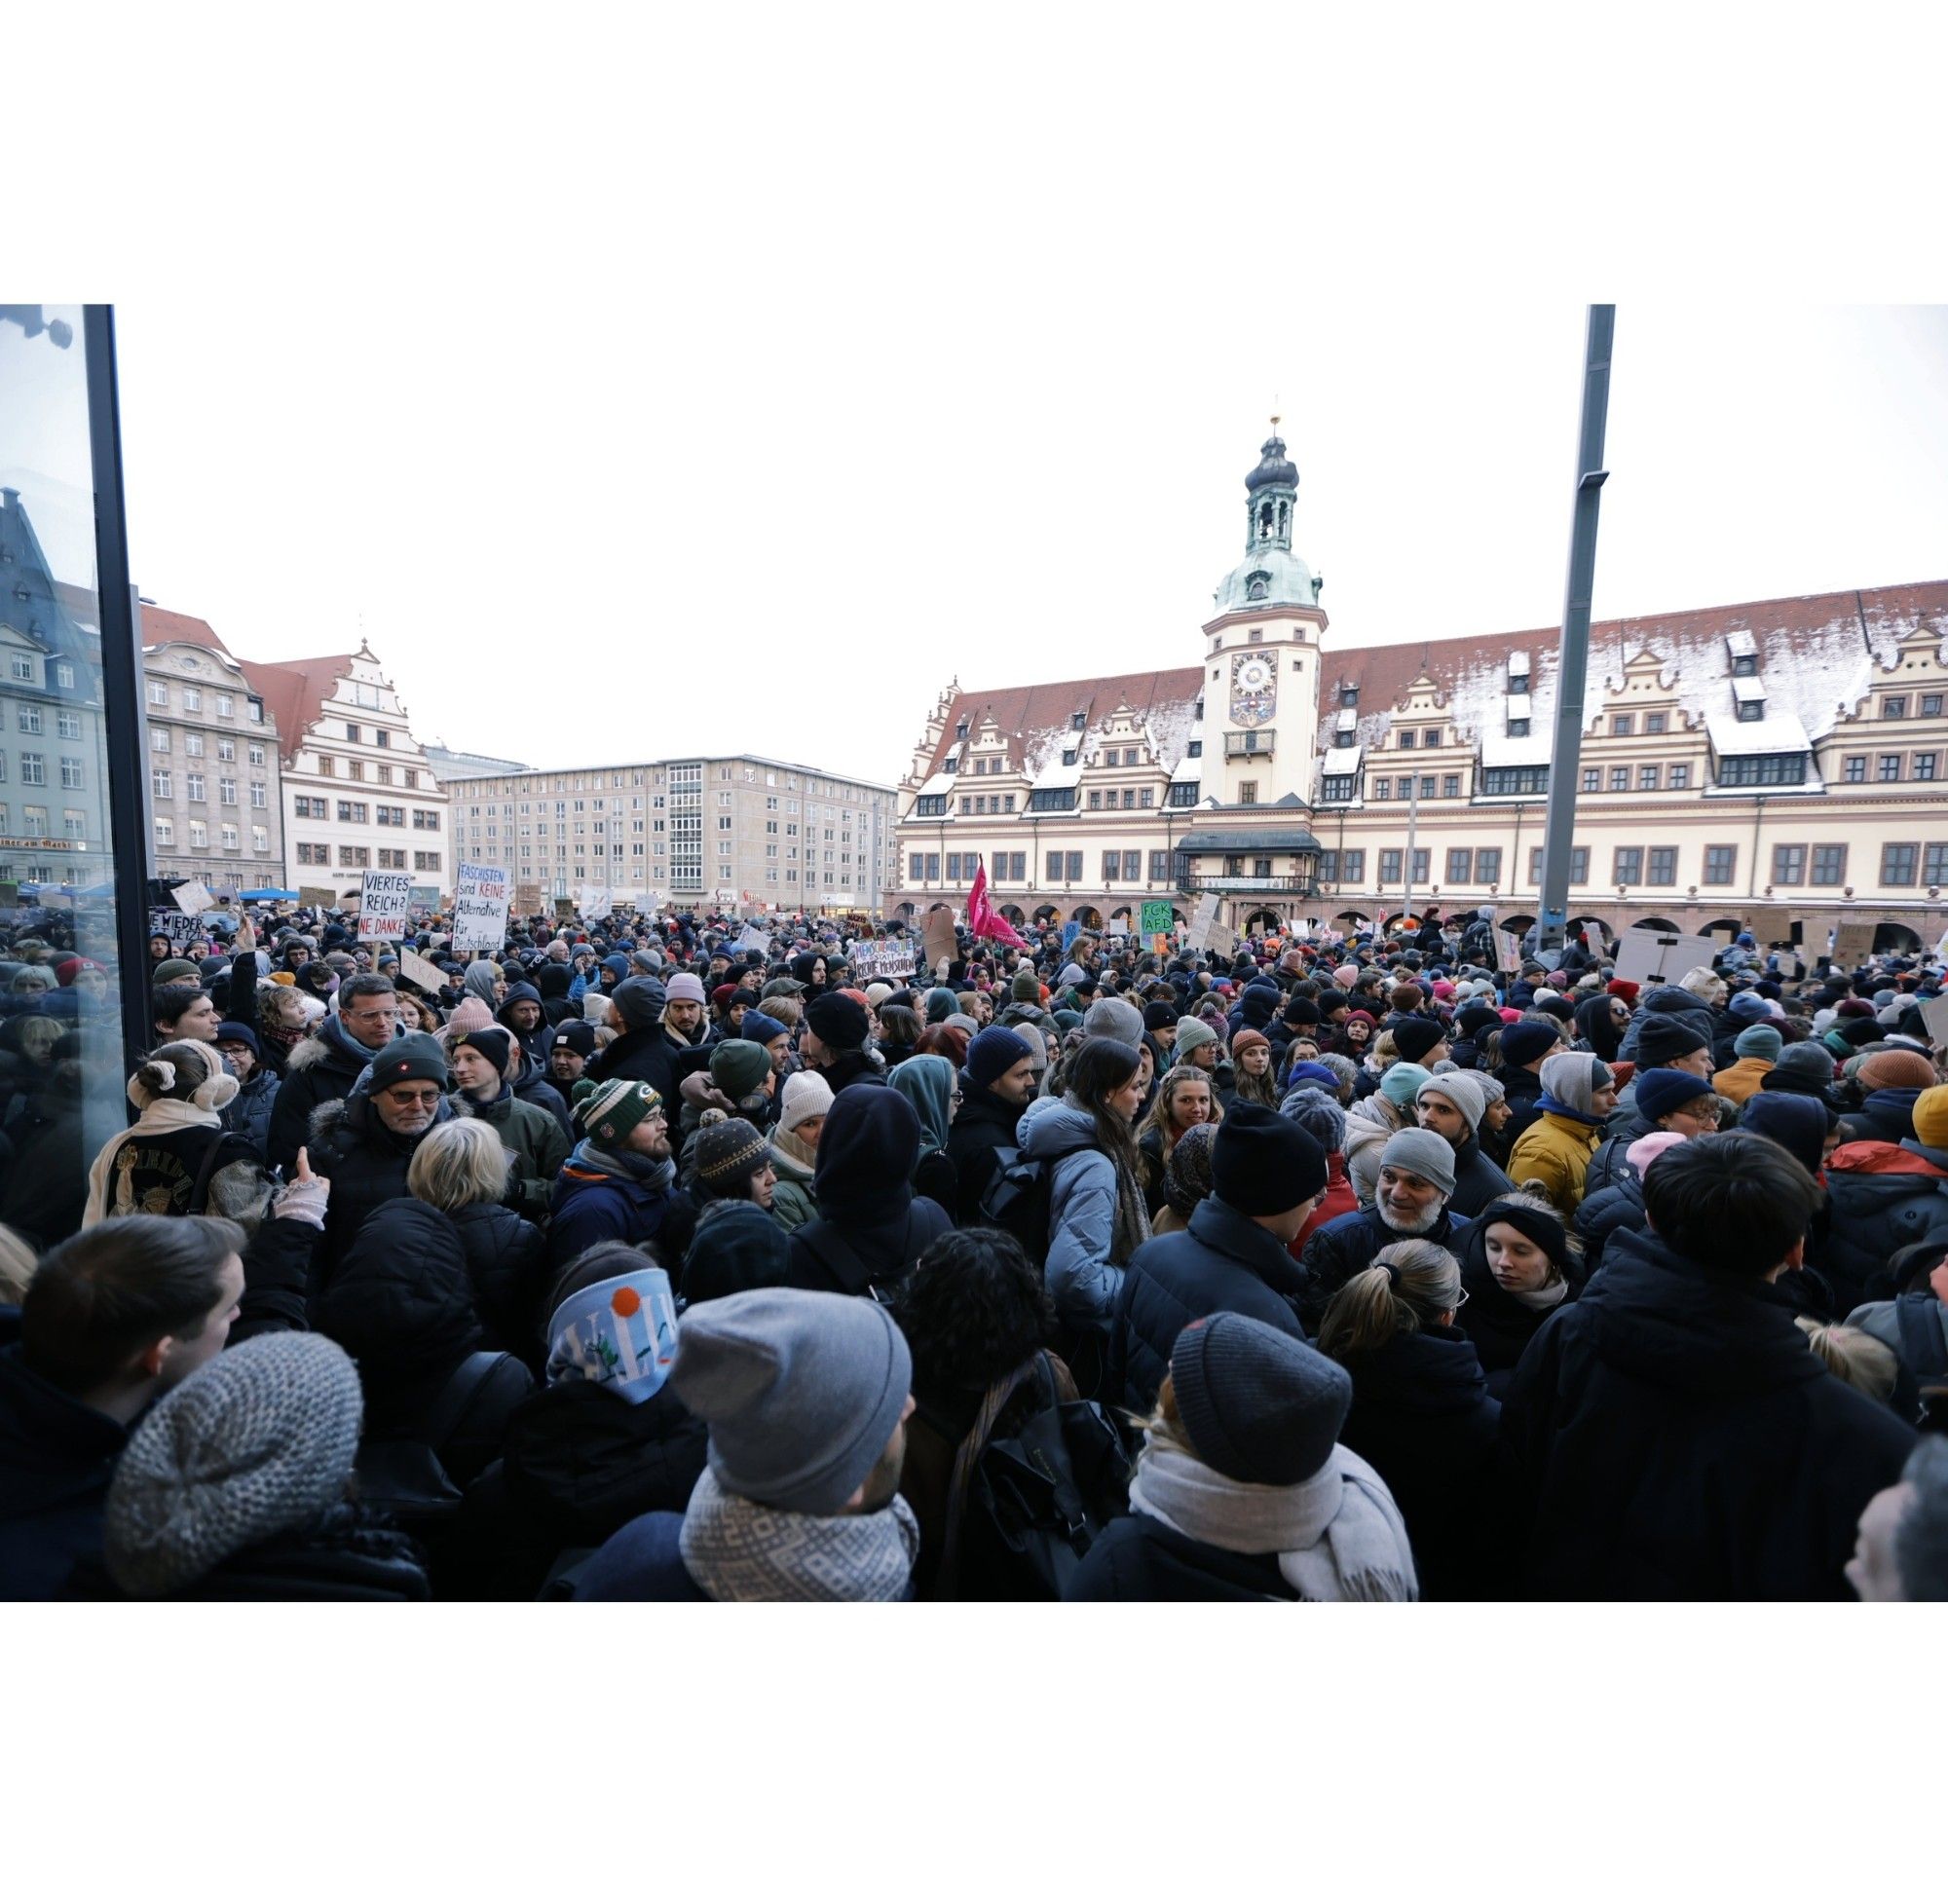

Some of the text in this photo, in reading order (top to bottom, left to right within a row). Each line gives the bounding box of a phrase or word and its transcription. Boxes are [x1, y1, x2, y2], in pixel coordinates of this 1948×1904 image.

[461, 865, 505, 882] FASCHISTEN
[365, 875, 409, 891] VIERTES
[458, 880, 475, 895] sind
[478, 882, 505, 899] KEINE
[366, 894, 406, 912] REICH?
[456, 899, 502, 917] Alternative
[1143, 903, 1170, 916] FCK
[162, 915, 203, 932] WIEDER
[359, 917, 405, 935] NE DANKE
[455, 918, 468, 935] für
[1144, 918, 1173, 930] AFD
[454, 935, 502, 950] Deutschland
[880, 957, 916, 975] MENSCHEN
